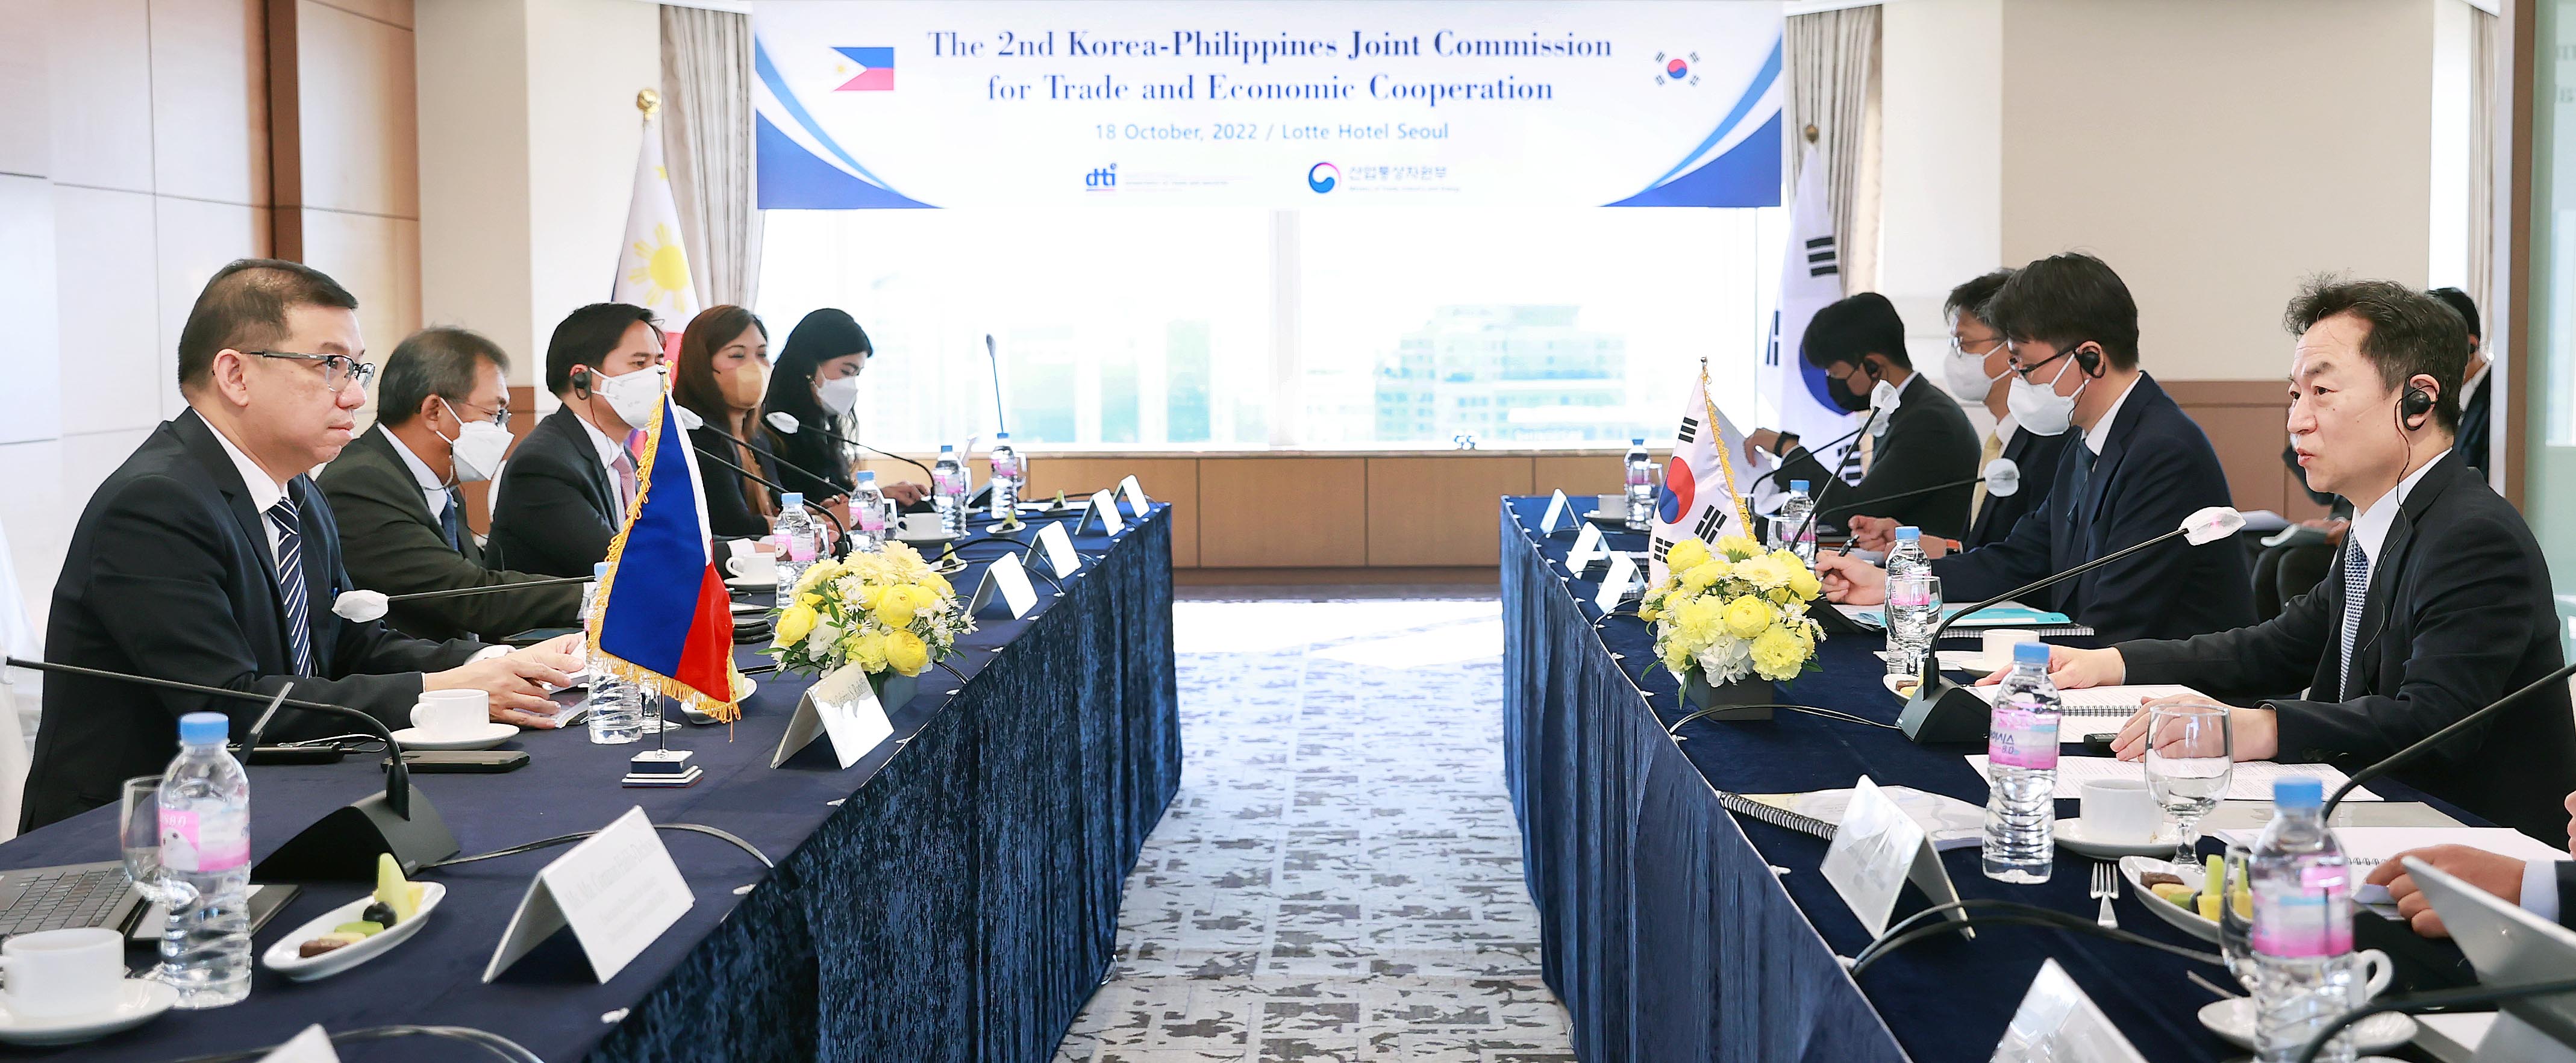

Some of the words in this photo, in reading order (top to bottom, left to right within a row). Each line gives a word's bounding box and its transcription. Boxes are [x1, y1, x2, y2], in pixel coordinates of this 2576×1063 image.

[928, 31, 984, 57] The
[998, 31, 1054, 57] 2nd
[1069, 30, 1337, 64] Korea-Philippines
[1348, 30, 1421, 60] Joint
[1434, 30, 1612, 57] Commission
[989, 75, 1031, 100] for
[1043, 74, 1128, 100] Trade
[1143, 74, 1194, 100] and
[1208, 74, 1355, 100] Economic
[1370, 74, 1553, 107] Cooperation
[1096, 124, 1116, 139] 18
[1125, 123, 1203, 142] October,
[1213, 123, 1257, 140] 2022
[1267, 124, 1274, 141] /
[1283, 124, 1330, 139] Lotte
[1339, 123, 1389, 139] Hotel
[1398, 122, 1448, 139] Seoul
[1349, 165, 1447, 181] 산업통상자원부
